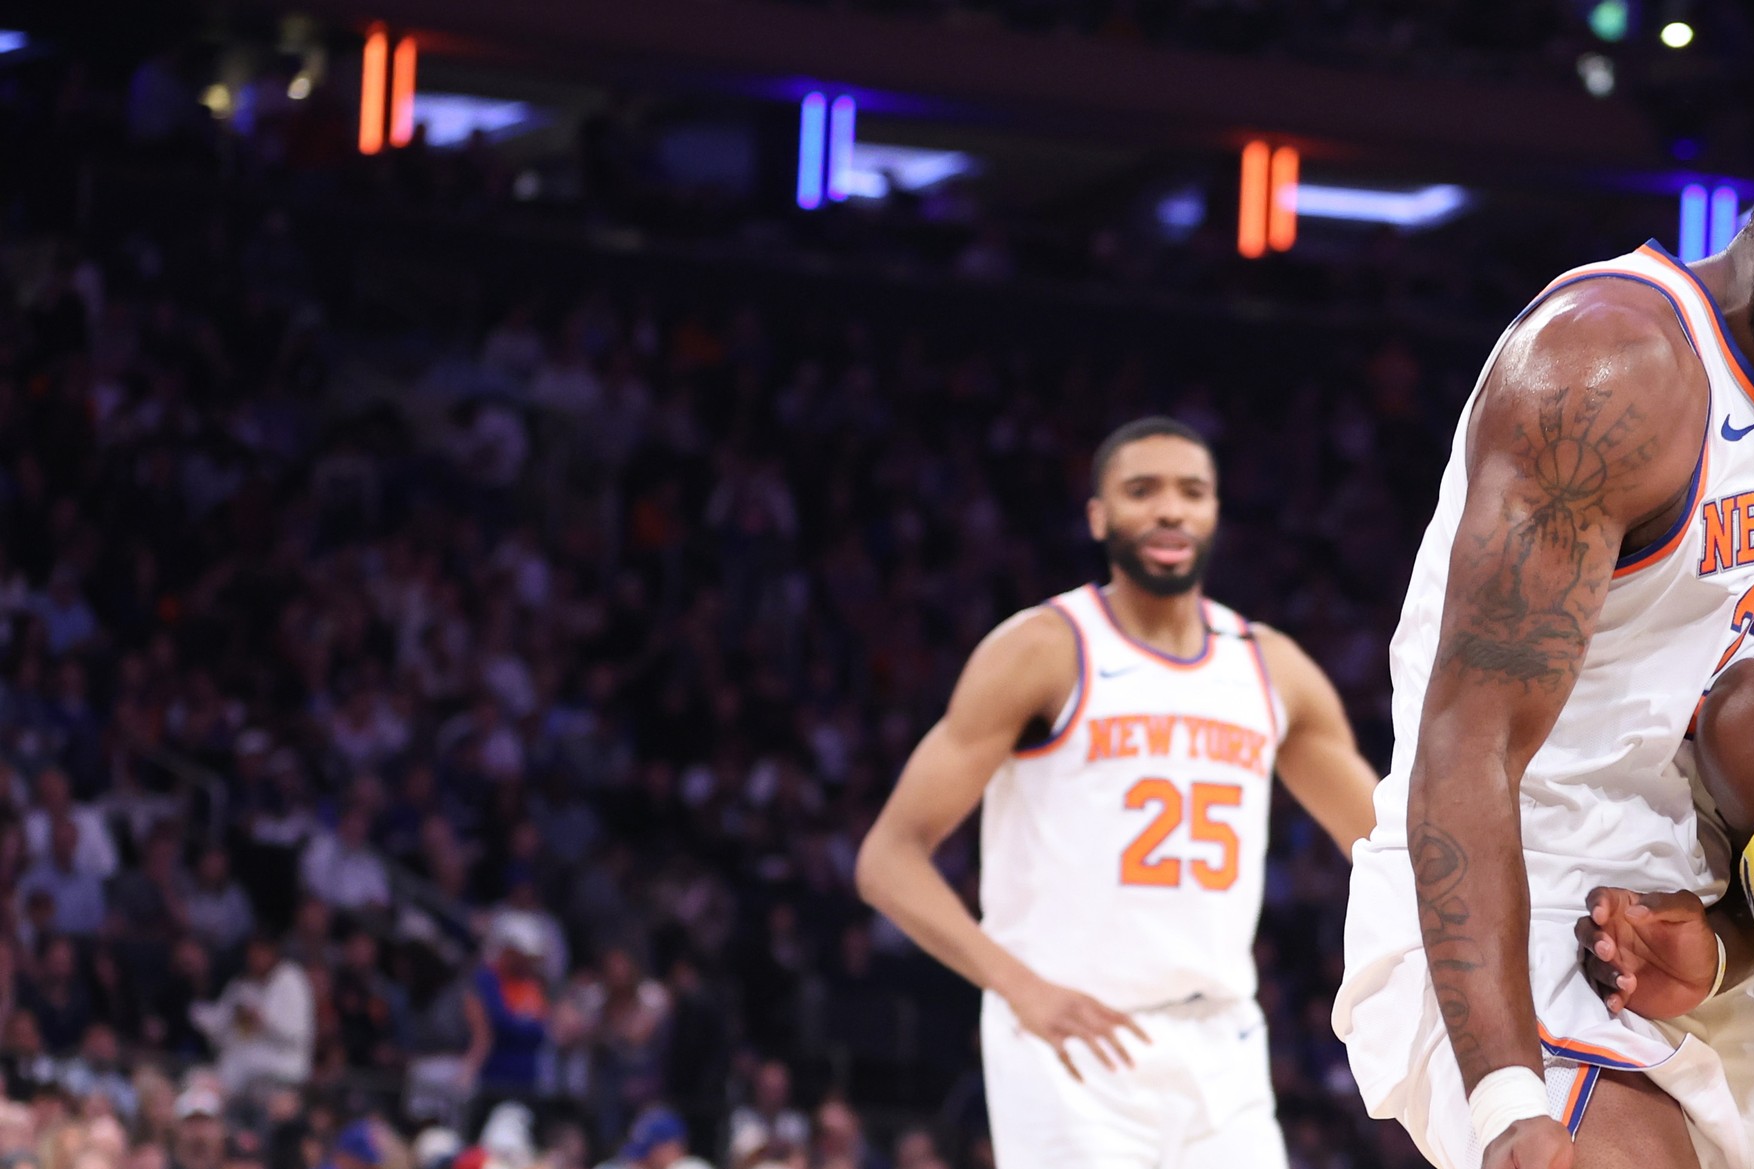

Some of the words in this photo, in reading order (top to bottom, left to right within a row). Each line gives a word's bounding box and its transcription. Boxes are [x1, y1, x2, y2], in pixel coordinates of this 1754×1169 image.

[1086, 714, 1177, 763] NEW
[1181, 716, 1269, 780] YORK
[1120, 776, 1243, 892] 25
